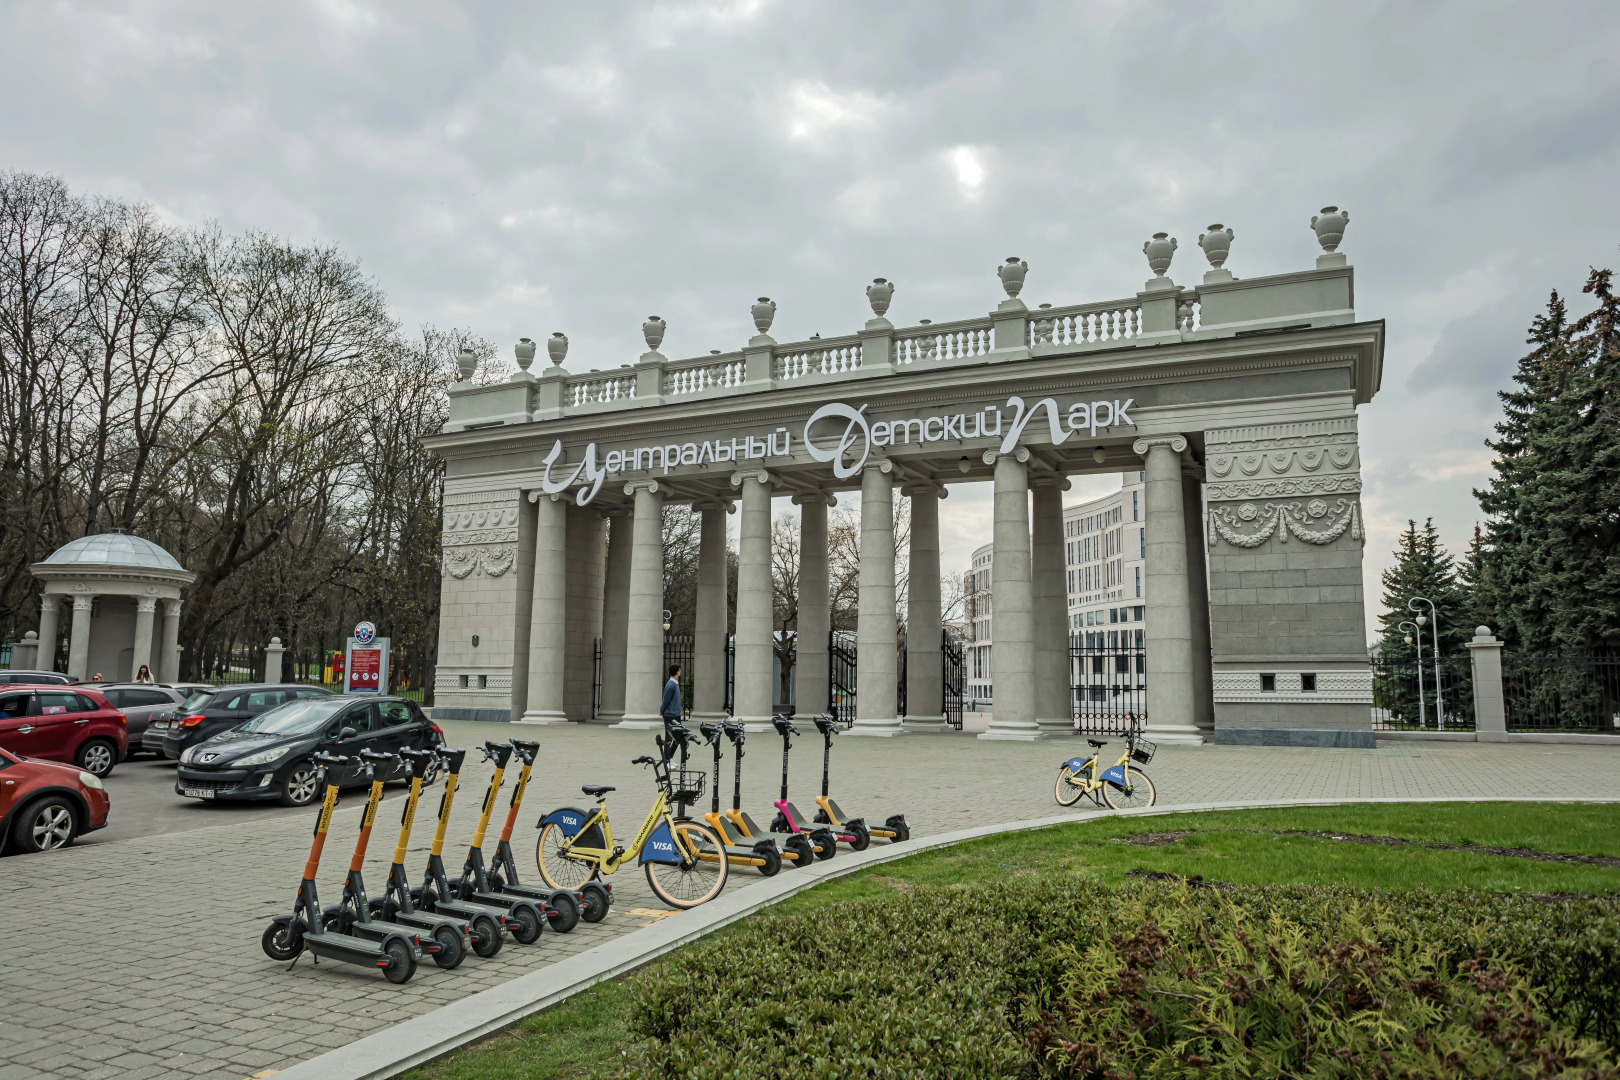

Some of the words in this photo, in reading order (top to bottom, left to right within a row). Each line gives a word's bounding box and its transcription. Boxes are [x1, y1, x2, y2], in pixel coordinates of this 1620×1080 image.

[542, 427, 790, 507] Центральный
[803, 402, 1001, 479] Детский
[1000, 396, 1135, 454] Парк
[1110, 771, 1122, 779] VISA
[321, 801, 332, 829] WHOOSH
[366, 796, 377, 823] WHOOSH
[441, 800, 451, 825] WHOOSH
[484, 793, 495, 817] WHOOSH
[404, 805, 414, 831] WHOOSH
[562, 815, 577, 826] VISA
[652, 841, 673, 852] VISA
